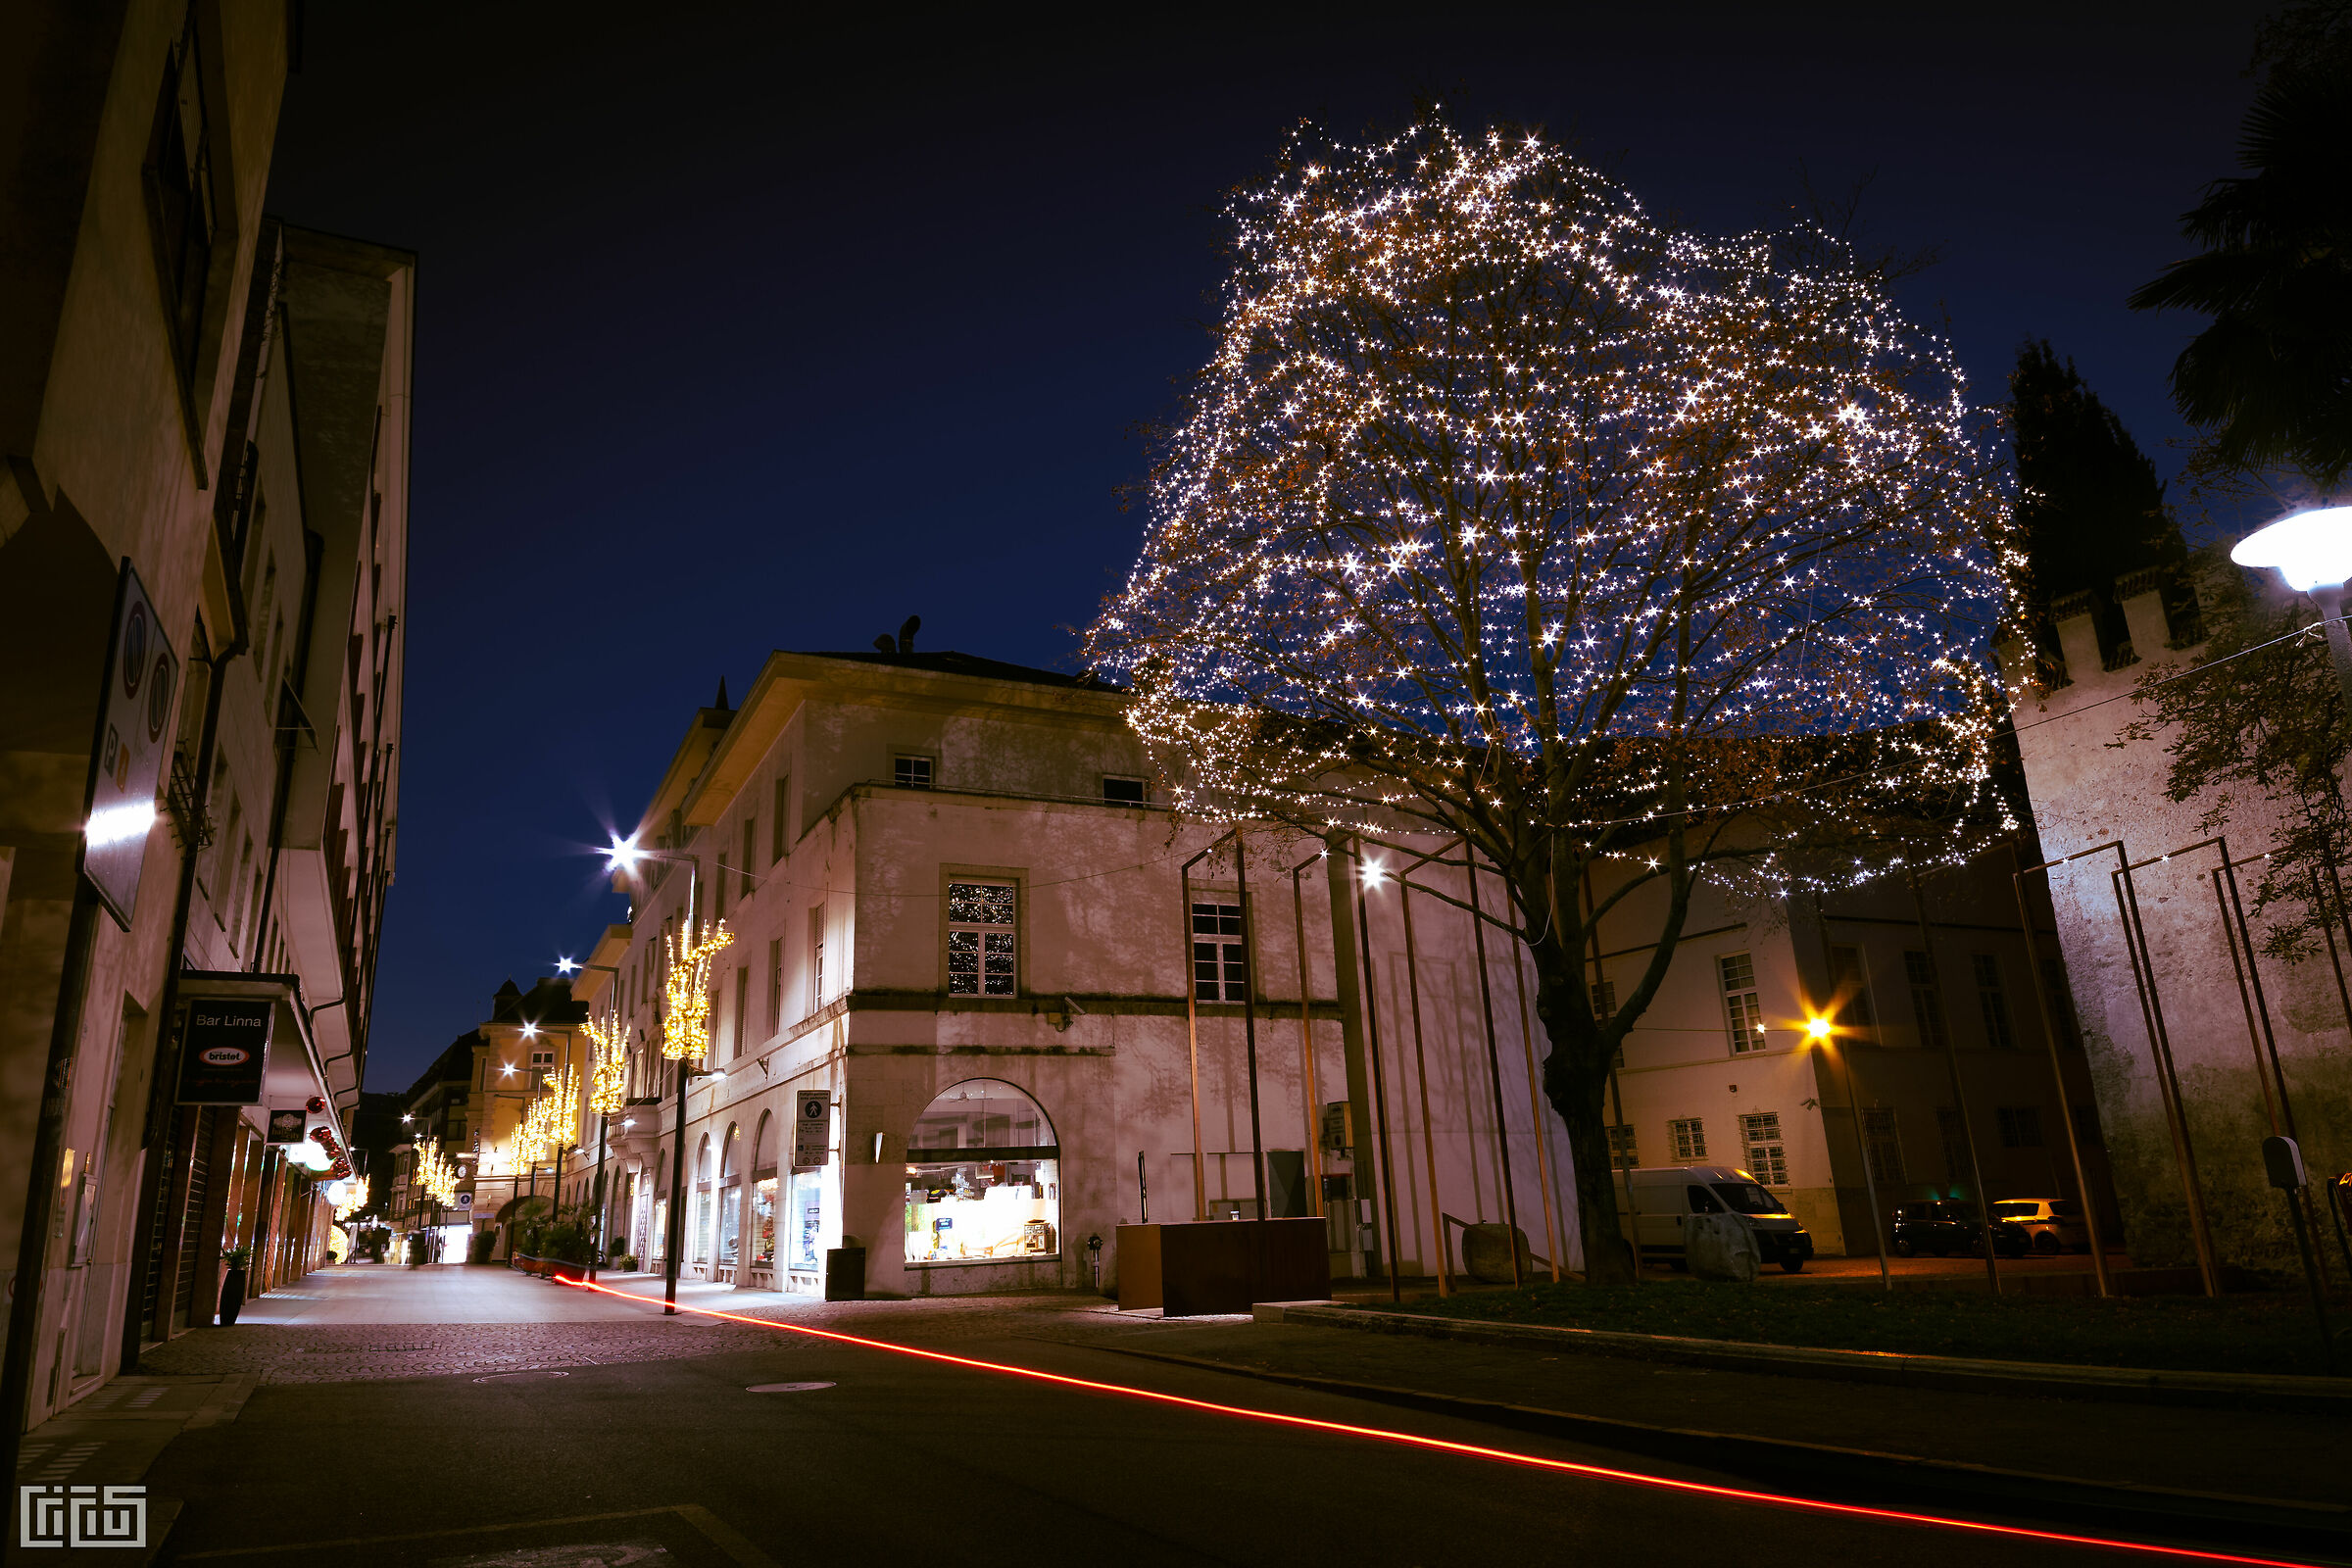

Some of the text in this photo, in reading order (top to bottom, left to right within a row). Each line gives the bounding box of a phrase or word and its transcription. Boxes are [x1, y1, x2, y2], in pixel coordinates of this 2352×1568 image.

[196, 1014, 262, 1027] Bar Linna
[209, 1052, 241, 1060] bristol
